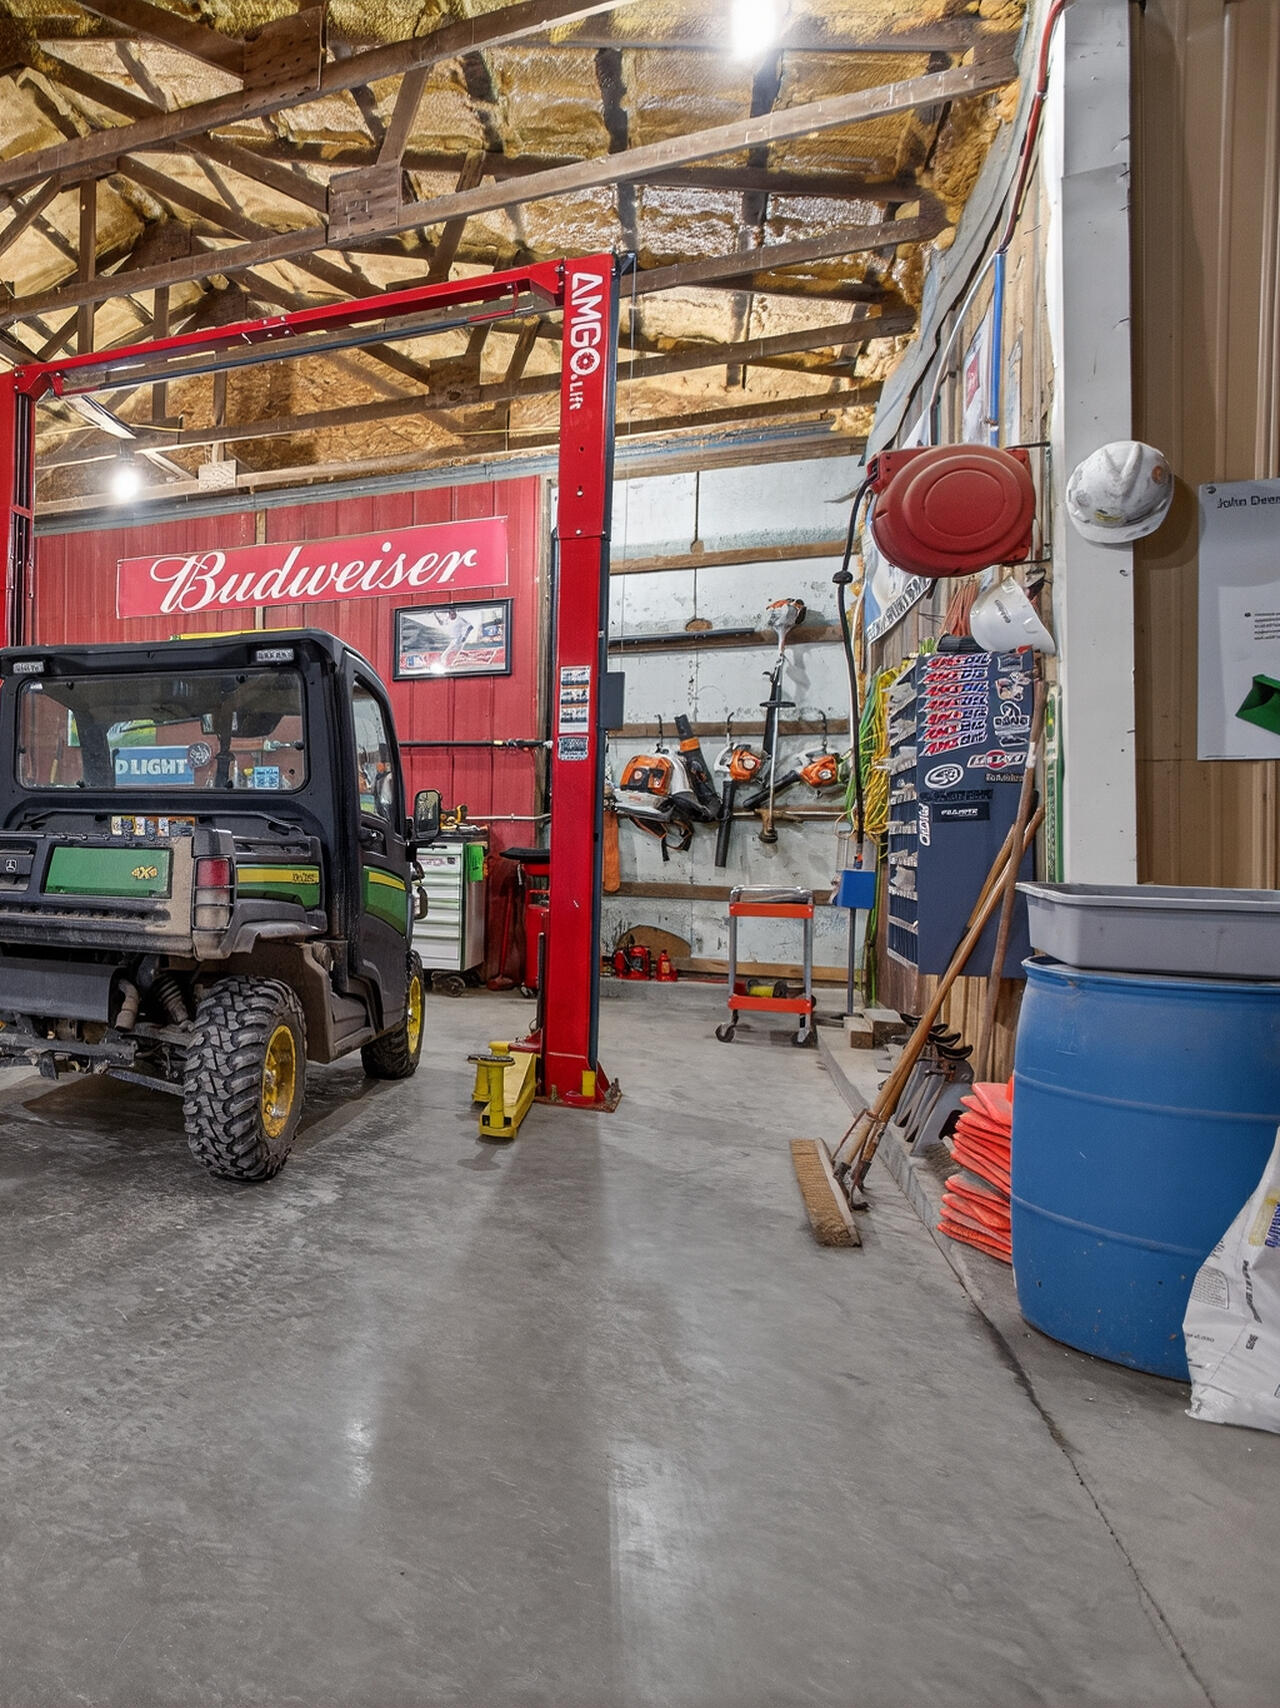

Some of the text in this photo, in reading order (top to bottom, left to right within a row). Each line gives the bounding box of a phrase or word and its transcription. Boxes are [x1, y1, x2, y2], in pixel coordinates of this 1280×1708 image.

[569, 272, 604, 376] AMGO
[1217, 497, 1247, 508] John
[150, 542, 477, 614] Budweiser
[130, 758, 188, 775] LIGHT
